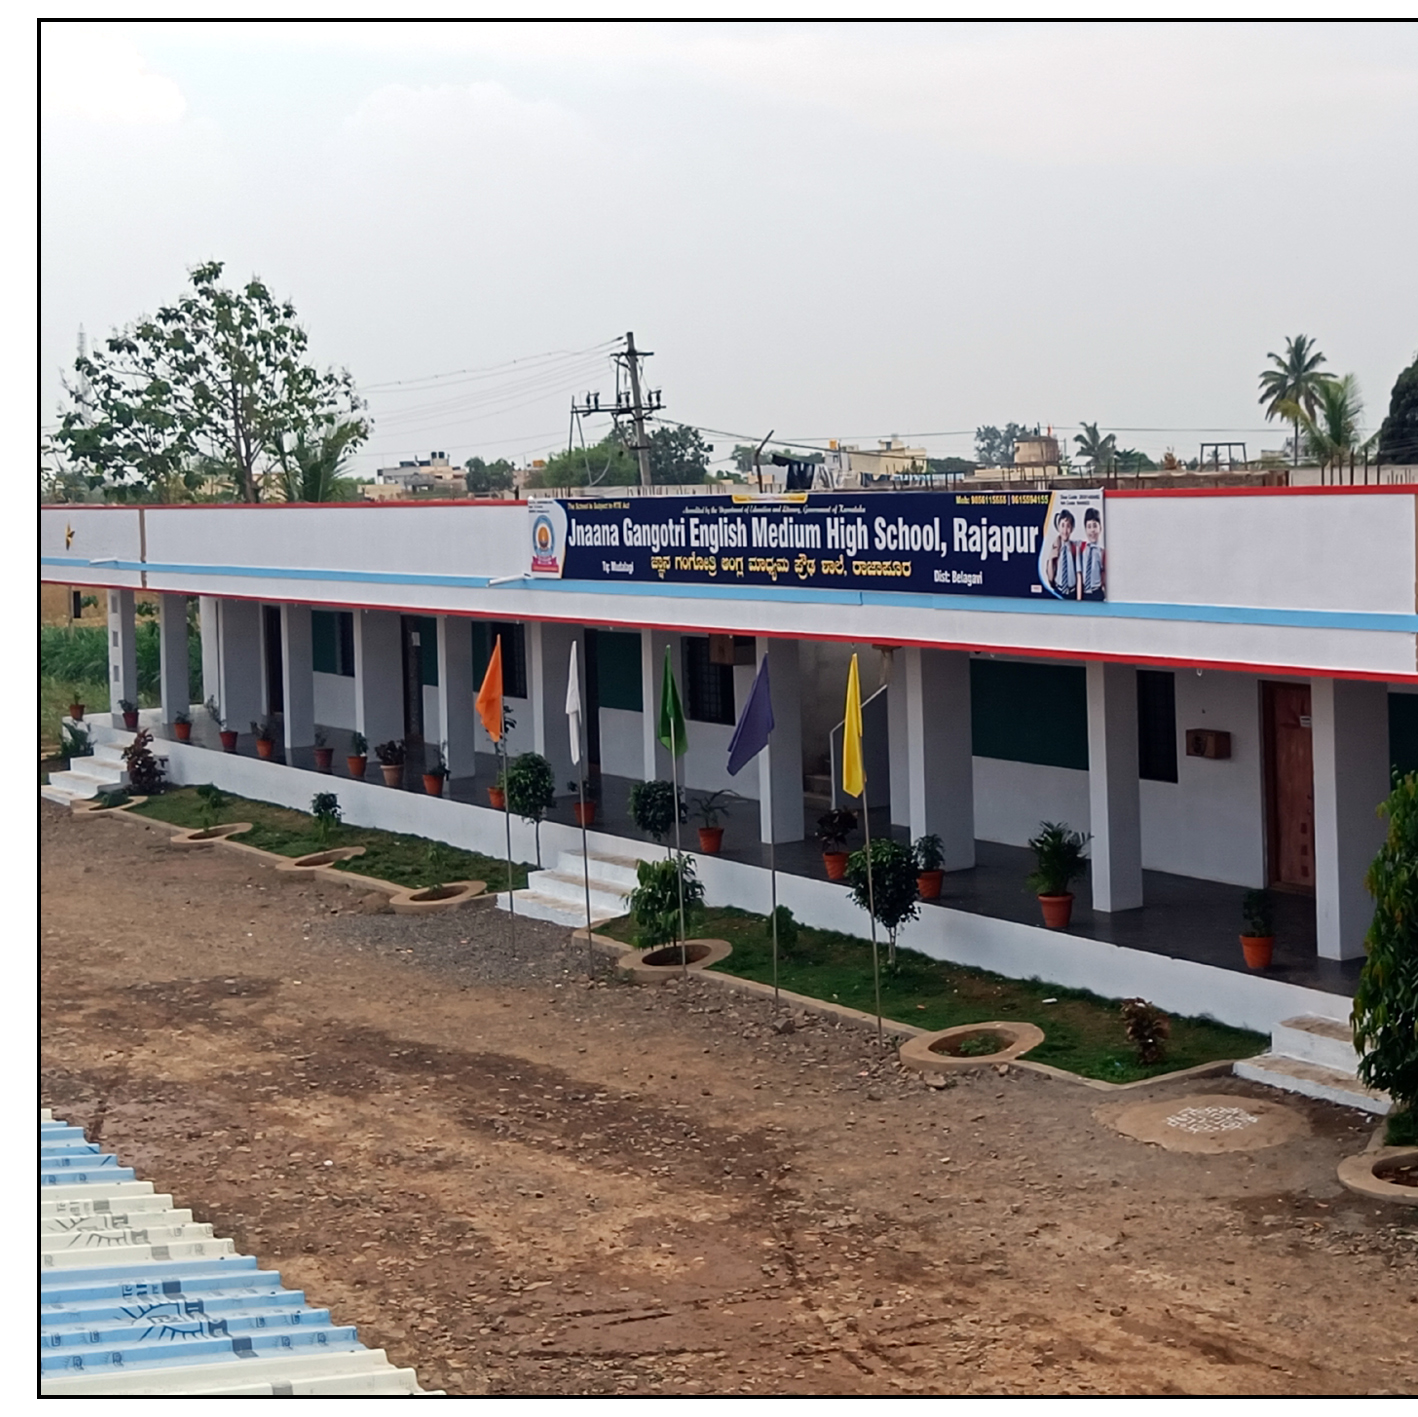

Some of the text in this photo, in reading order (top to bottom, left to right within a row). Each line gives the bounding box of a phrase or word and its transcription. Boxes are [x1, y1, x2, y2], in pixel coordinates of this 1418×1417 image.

[568, 516, 1039, 562] Jnaana Gangotri English Medium High School, Rajapur
[952, 570, 983, 587] Belagavi
